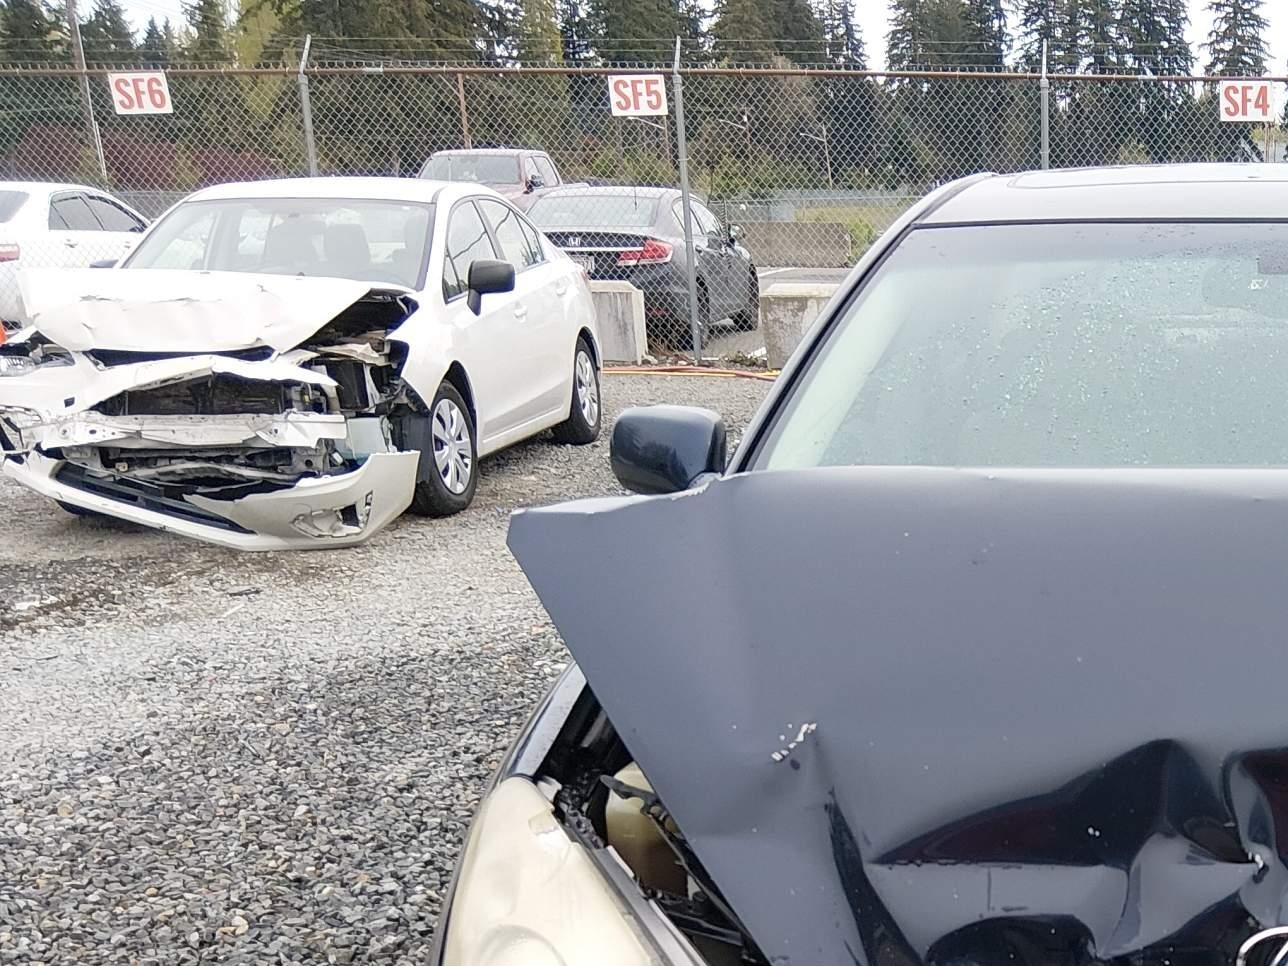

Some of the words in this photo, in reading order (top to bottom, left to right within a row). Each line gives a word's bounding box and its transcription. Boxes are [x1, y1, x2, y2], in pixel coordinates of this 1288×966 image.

[114, 77, 167, 110] SF6
[613, 79, 662, 111] SF5
[1223, 85, 1270, 117] SF4
